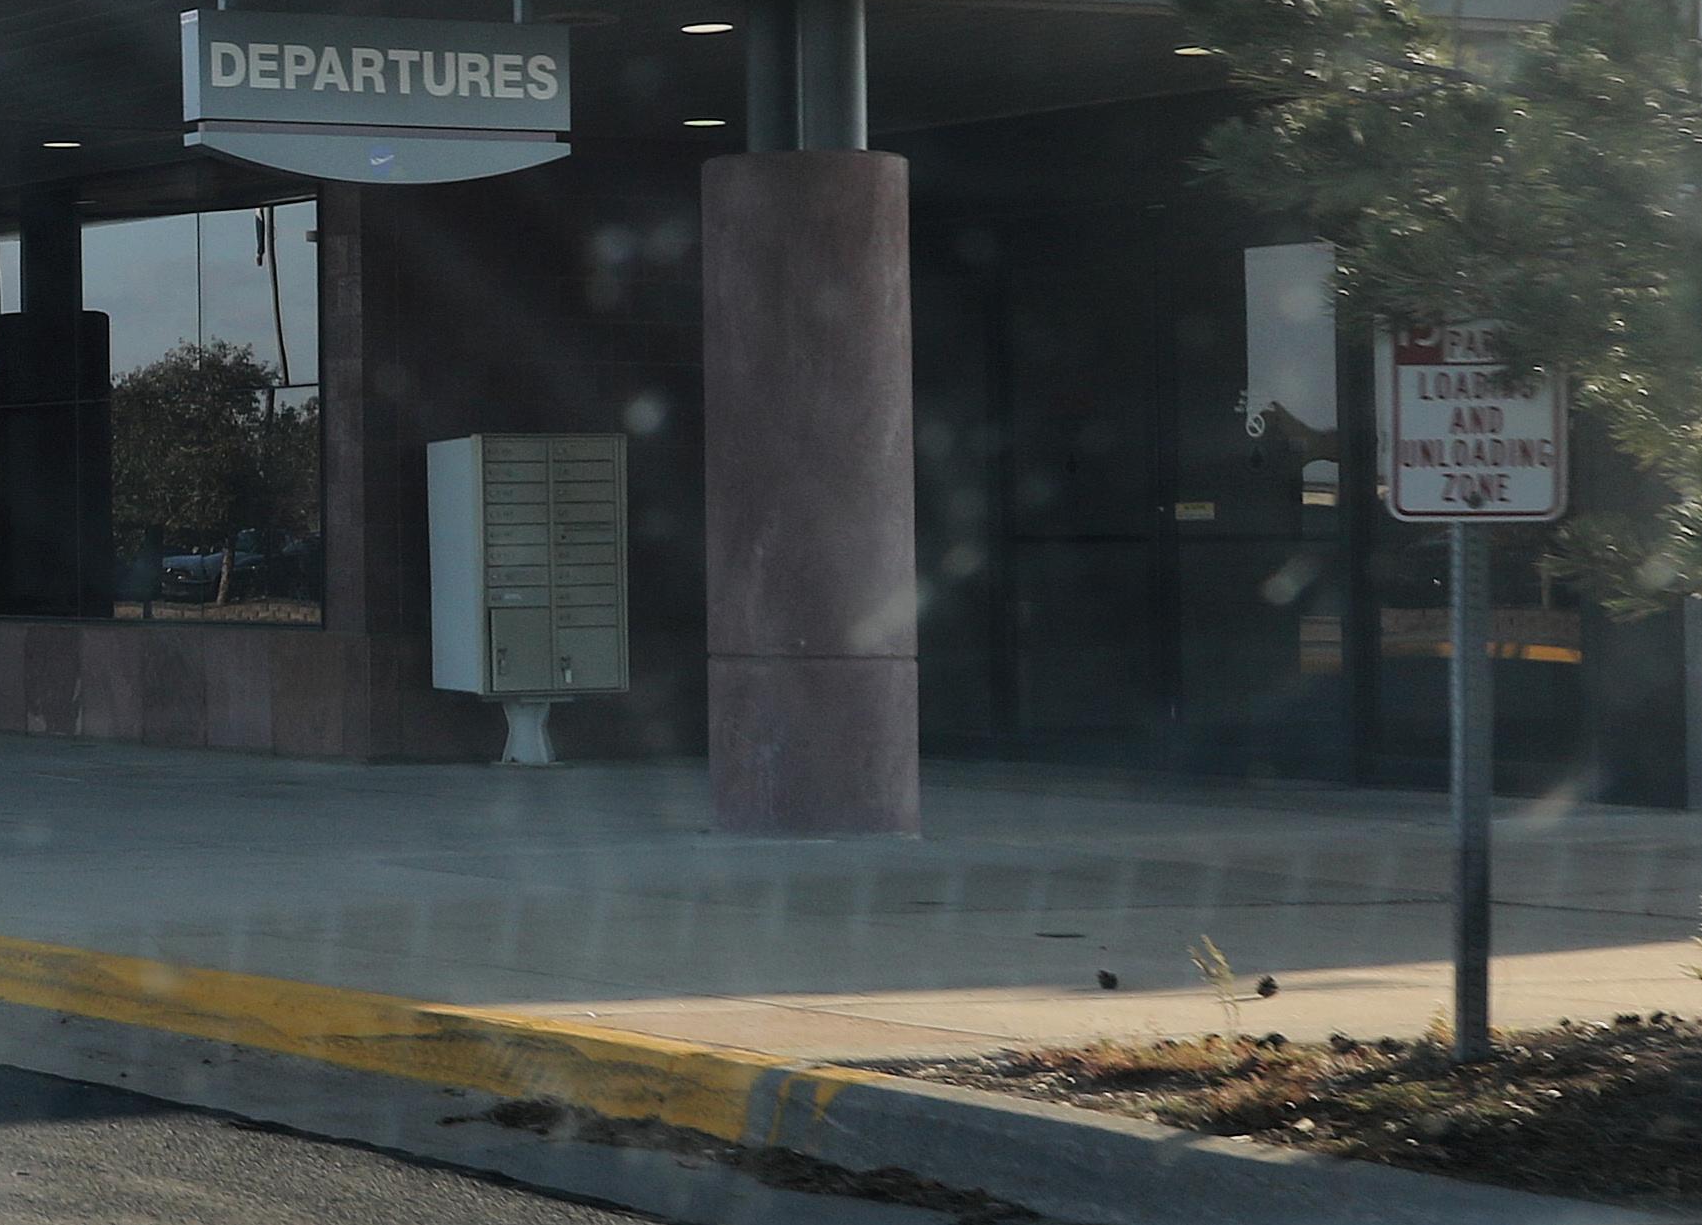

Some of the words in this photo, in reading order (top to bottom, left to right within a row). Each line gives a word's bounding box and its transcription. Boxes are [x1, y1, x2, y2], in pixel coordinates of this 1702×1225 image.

[210, 41, 559, 100] DEPARTURES
[1450, 406, 1504, 435] AND
[1400, 439, 1554, 467] UNLOADING
[1442, 473, 1512, 503] ZONE
